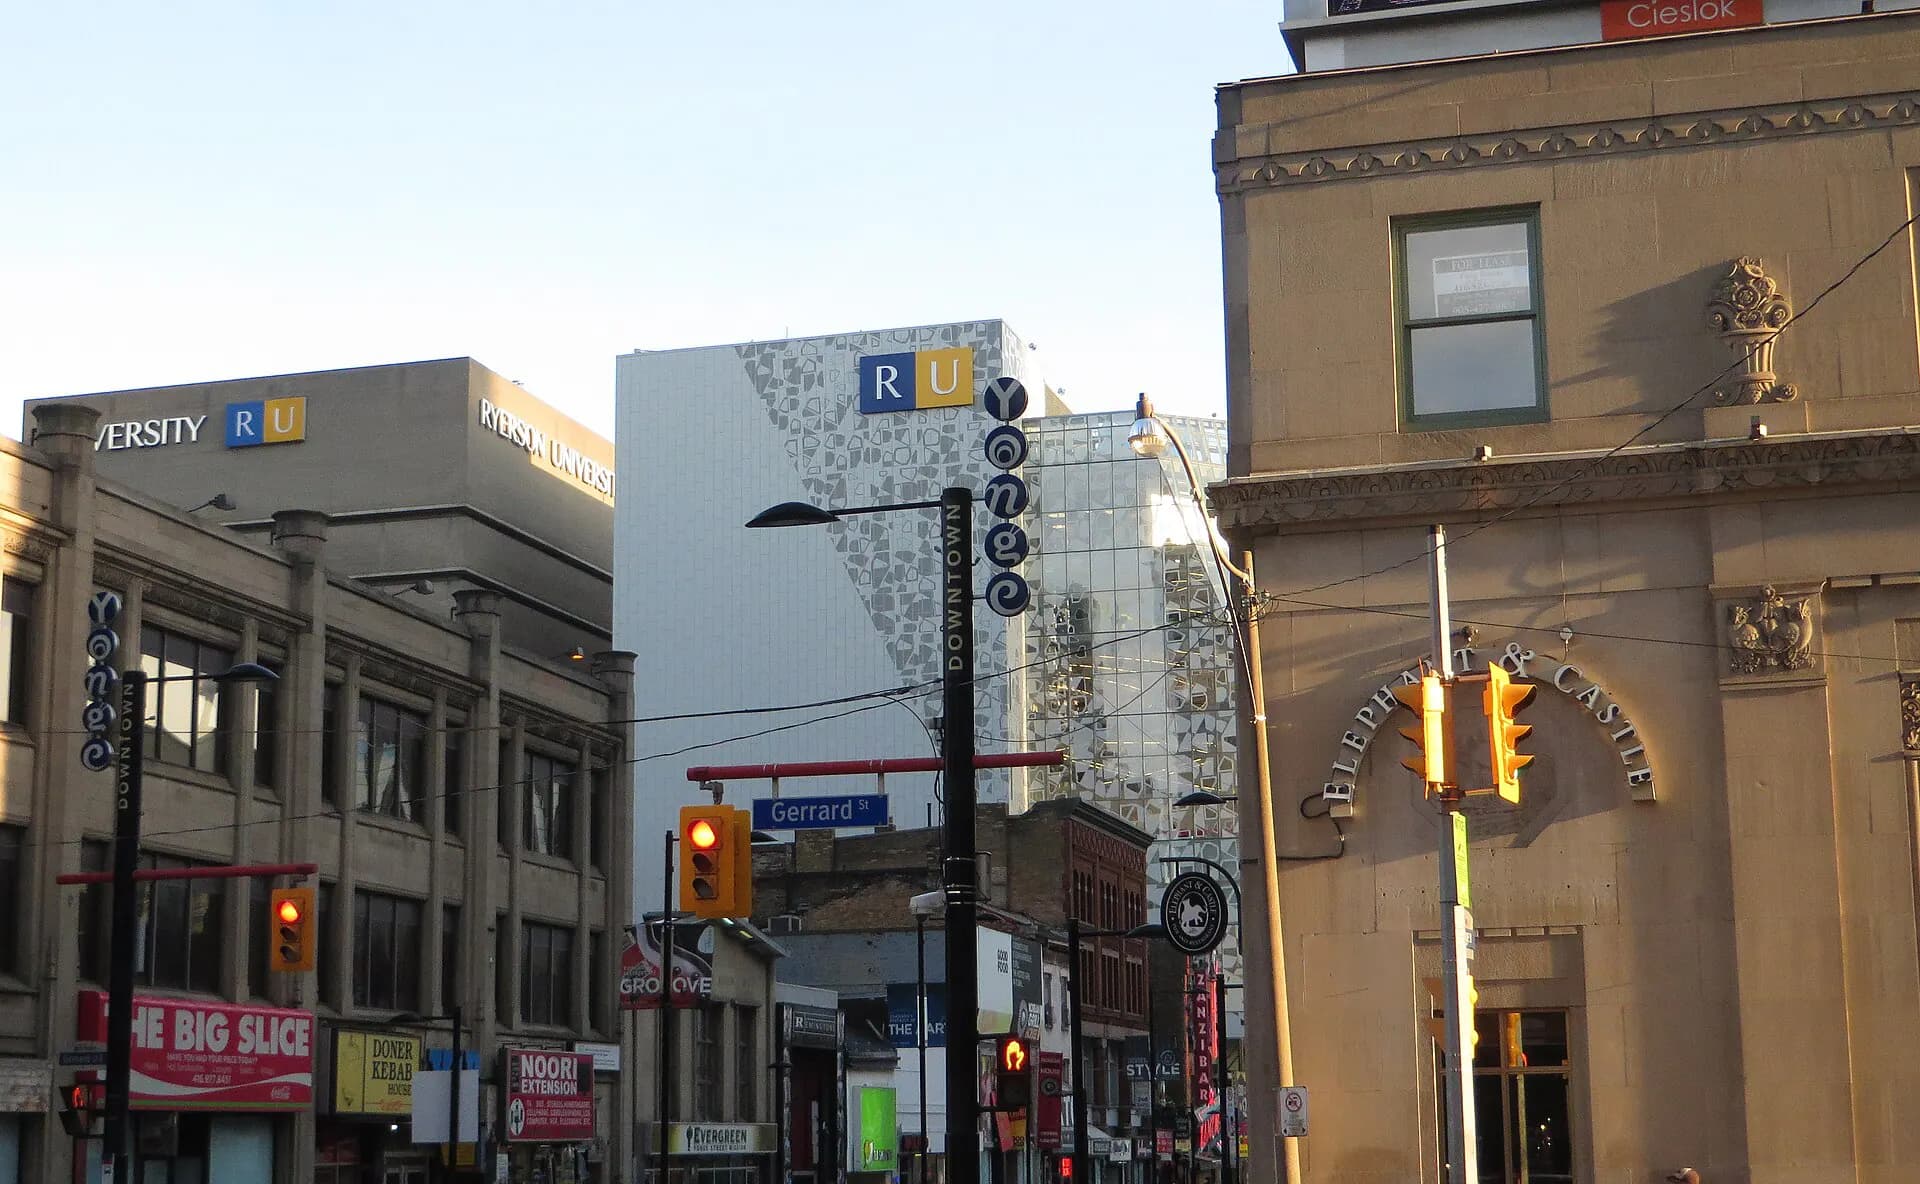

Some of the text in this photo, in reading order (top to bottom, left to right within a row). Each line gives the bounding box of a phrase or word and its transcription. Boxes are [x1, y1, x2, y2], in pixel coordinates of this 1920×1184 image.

[1627, 0, 1736, 28] Cieslok
[876, 359, 959, 400] R U
[236, 406, 295, 437] R U
[480, 398, 547, 459] RYERSON
[946, 503, 964, 671] DOWNTOWN
[1322, 642, 1653, 800] ELEPHAT & CASTLE
[118, 683, 135, 810] DOWNTOWN
[771, 800, 869, 823] Gerrard St
[620, 977, 713, 994] GROOVE
[175, 1008, 230, 1053] BIG
[238, 1014, 309, 1057] SLICE
[888, 1023, 912, 1035] THE
[1196, 973, 1208, 1100] ZANZIBAR
[373, 1039, 413, 1060] DONER
[371, 1061, 412, 1081] KEBAB
[521, 1055, 578, 1080] NOORI
[388, 1083, 412, 1096] HOUSE
[521, 1079, 577, 1095] EXTENSION
[694, 1127, 747, 1143] EVERGREEN
